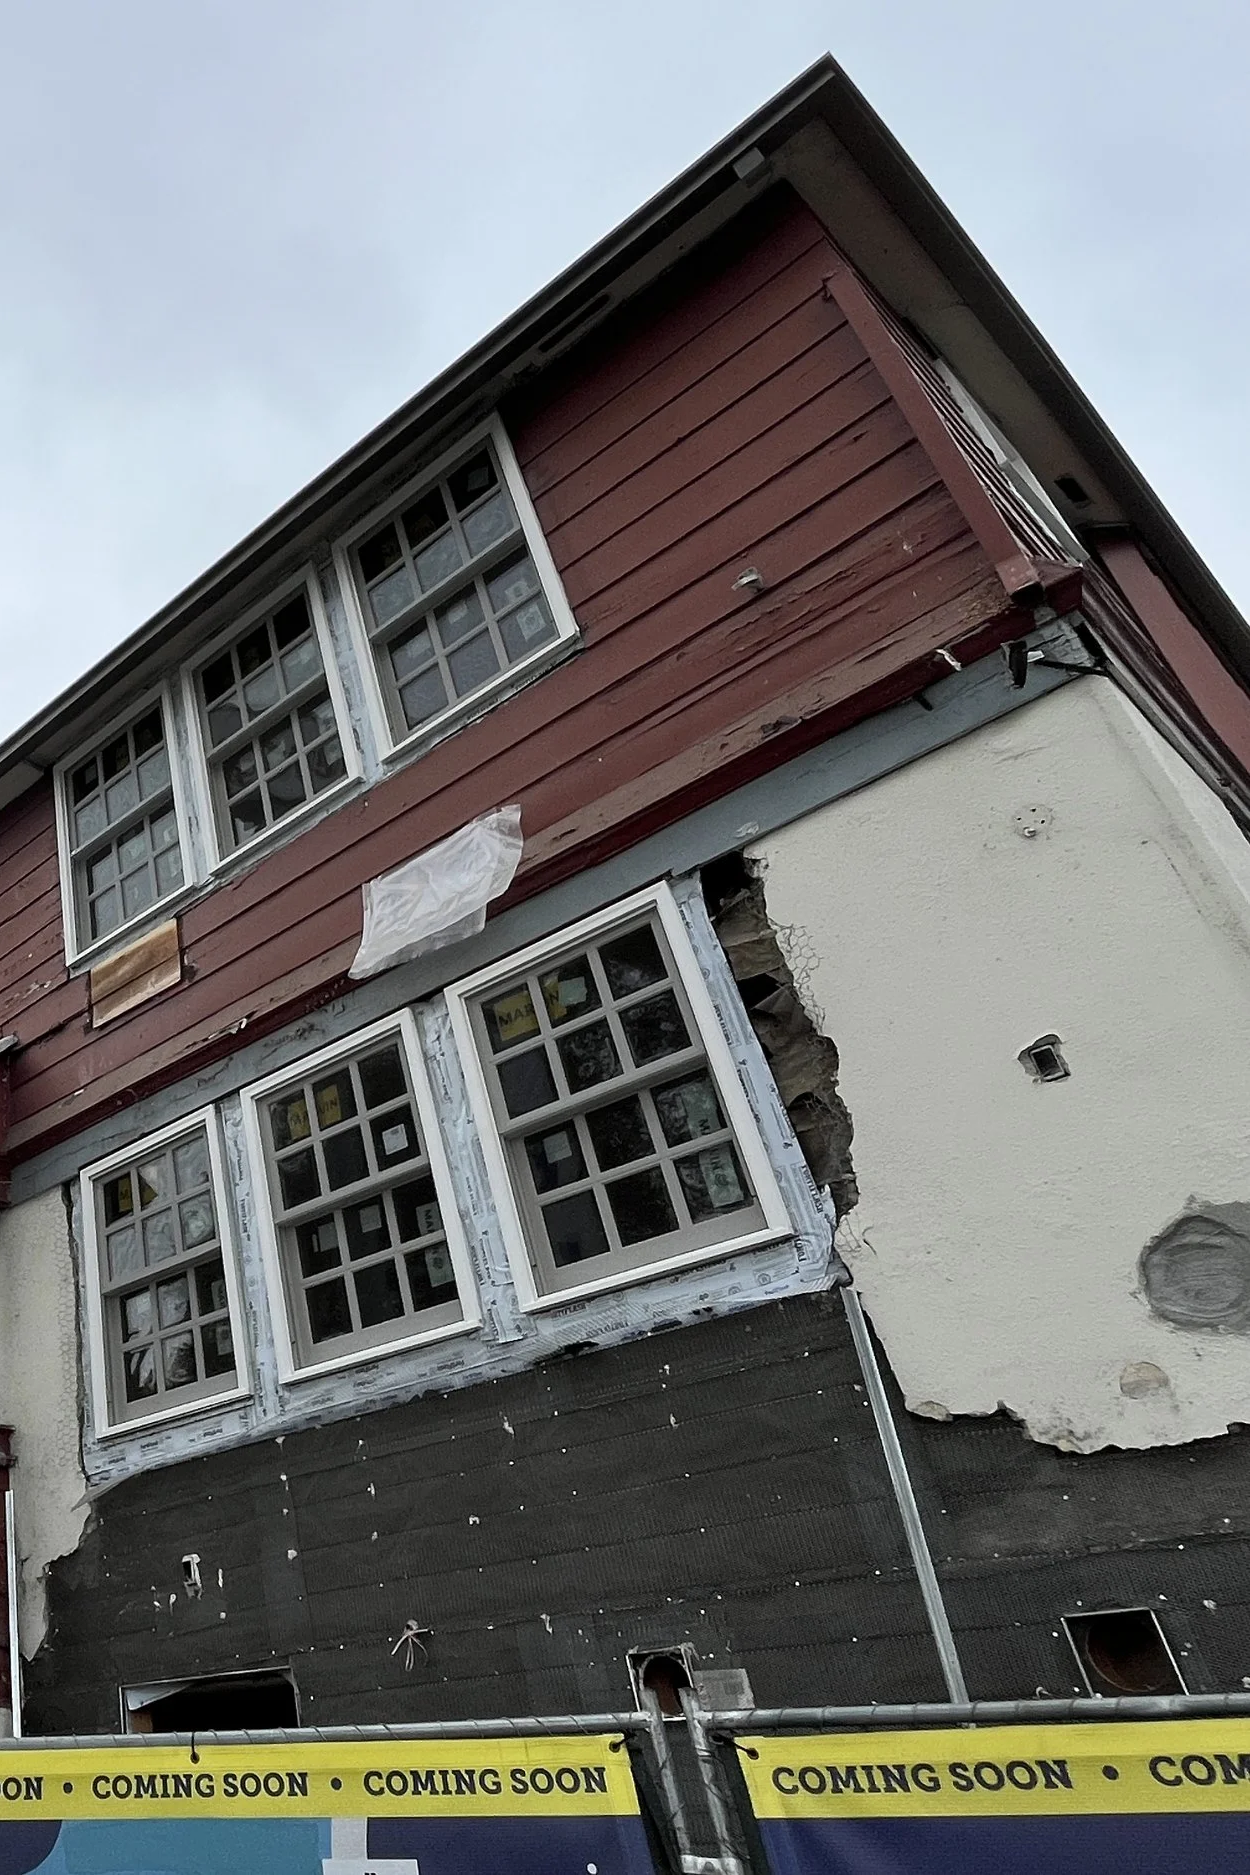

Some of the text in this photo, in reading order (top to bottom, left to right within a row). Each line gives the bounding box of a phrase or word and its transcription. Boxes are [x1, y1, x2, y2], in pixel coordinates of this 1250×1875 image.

[92, 1774, 215, 1799] COMING
[223, 1772, 309, 1797] SOON
[363, 1769, 503, 1796] COMING
[510, 1767, 607, 1795] SOON
[772, 1763, 941, 1794] COMING
[950, 1759, 1074, 1792] SOON
